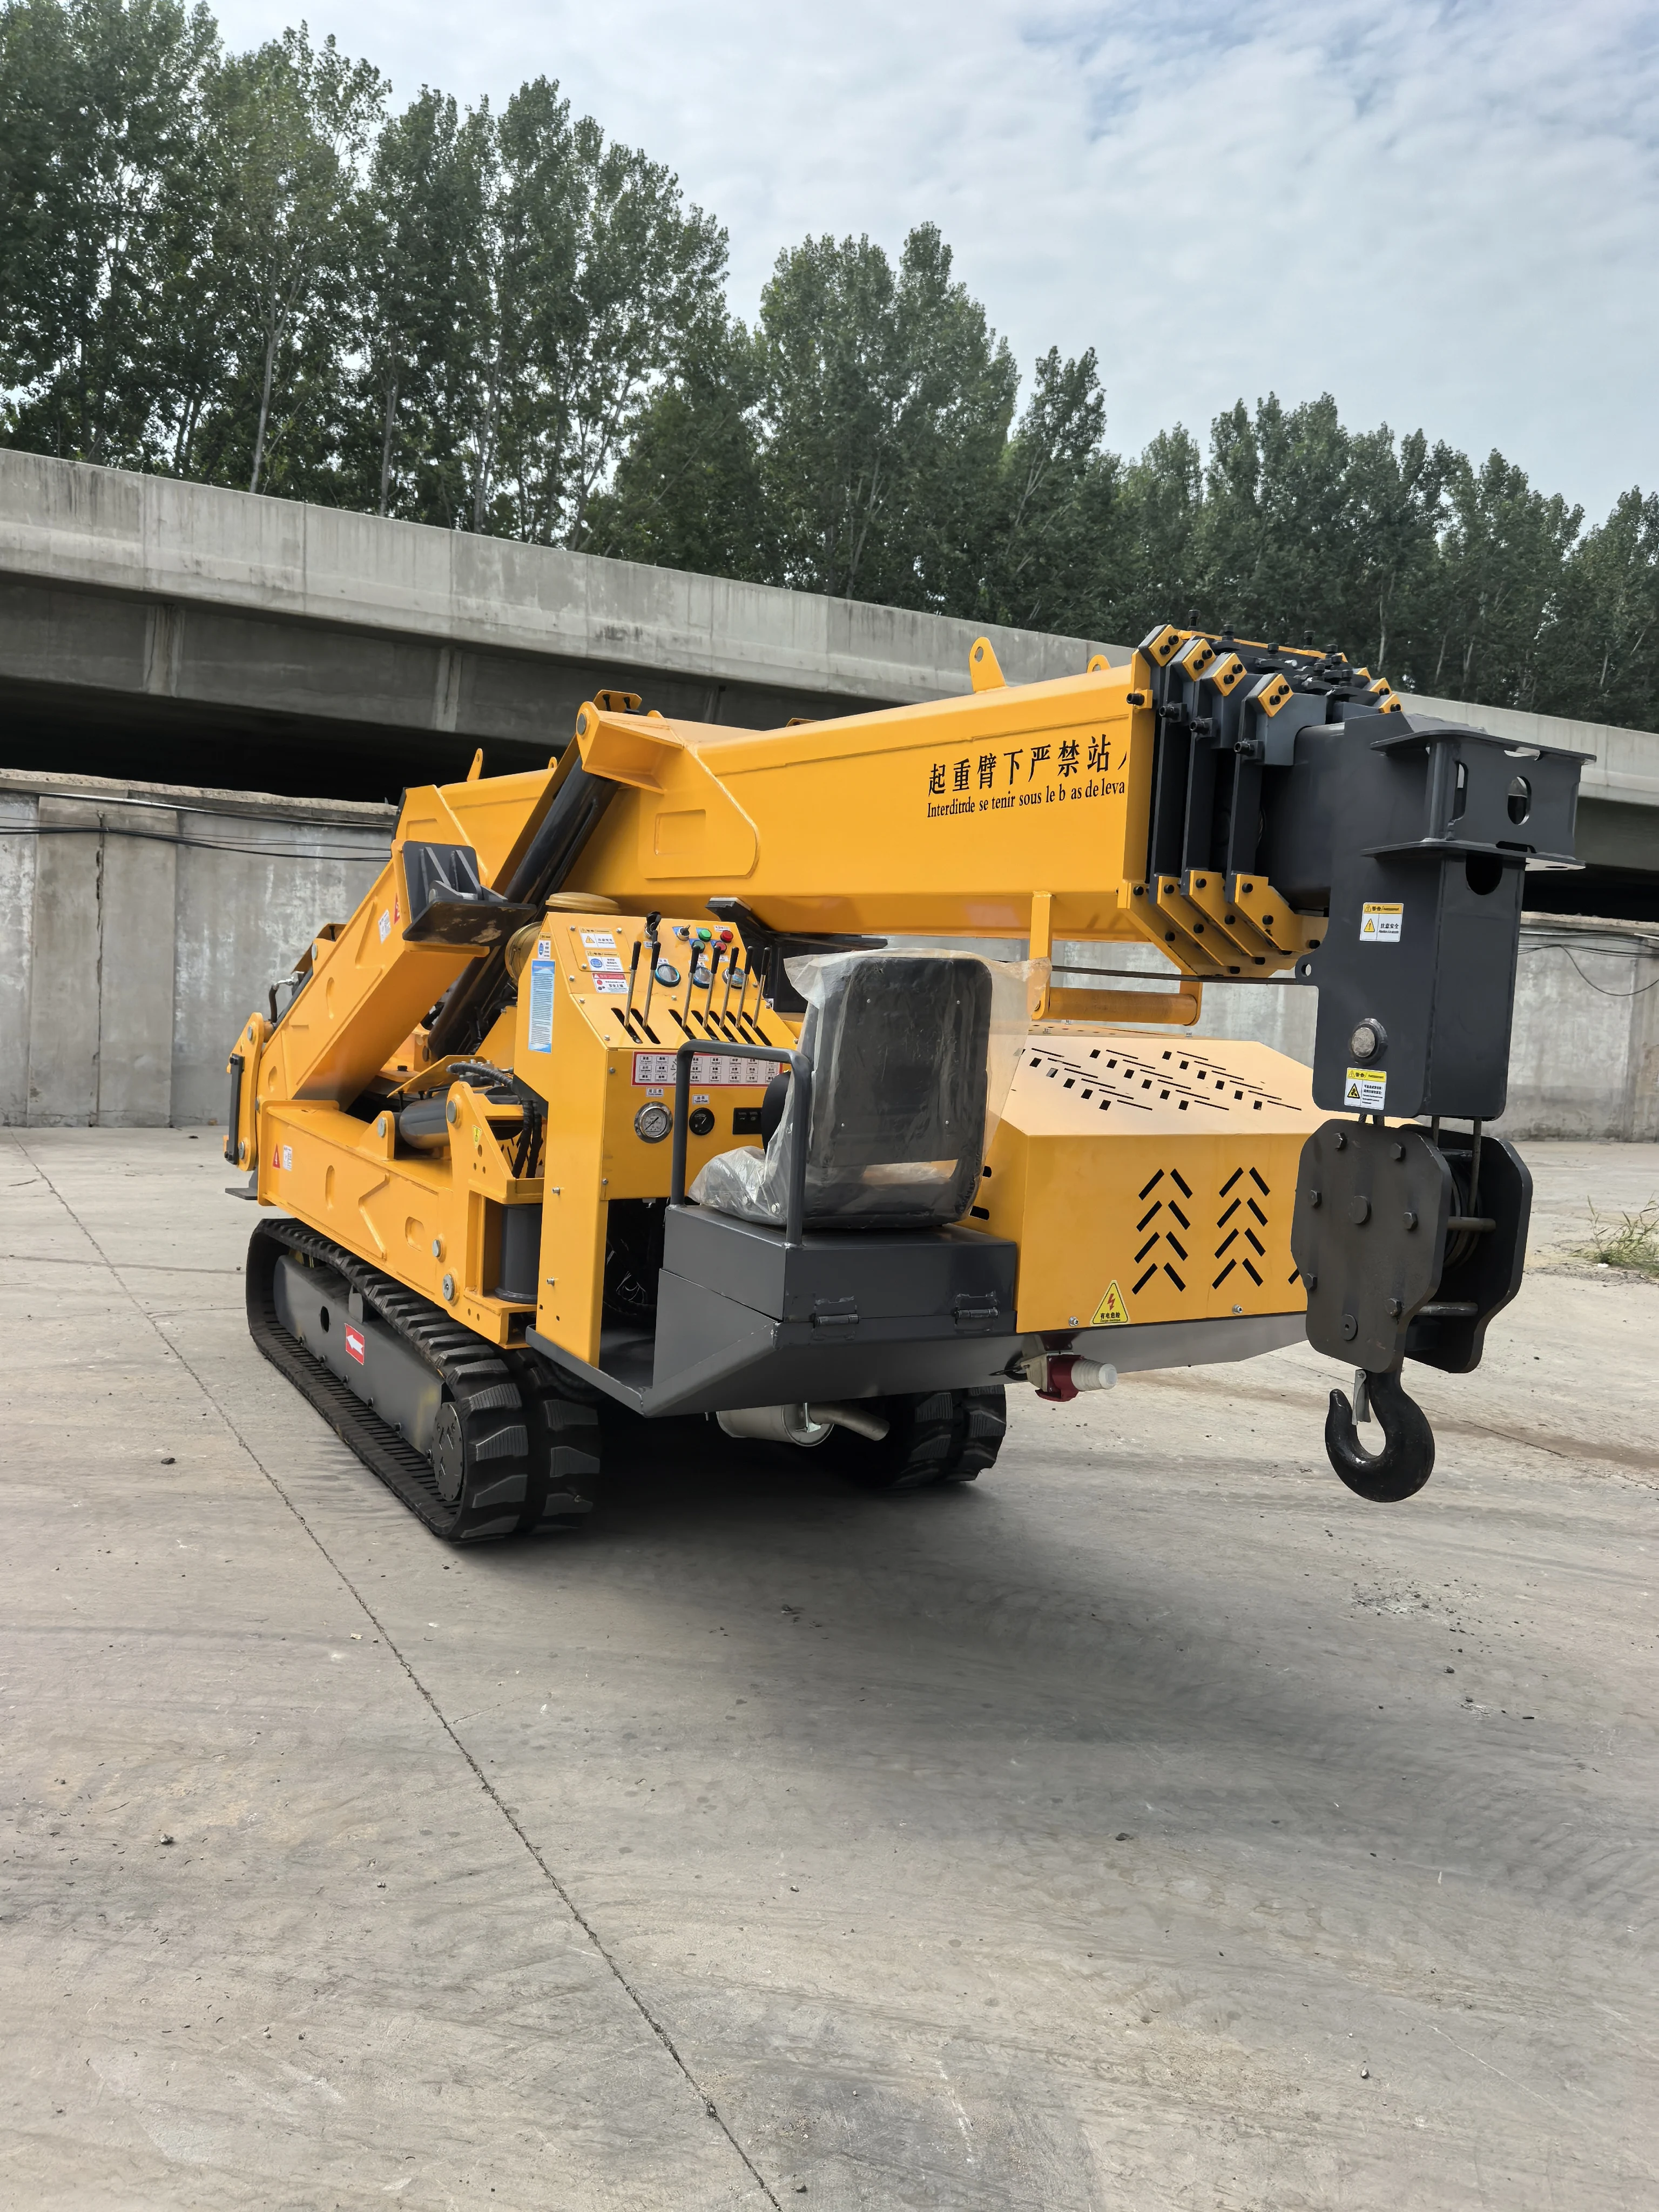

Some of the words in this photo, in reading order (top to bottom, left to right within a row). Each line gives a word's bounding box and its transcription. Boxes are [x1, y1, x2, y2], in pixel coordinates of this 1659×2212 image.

[979, 800, 989, 811] se
[992, 791, 1016, 810] tenir
[1019, 792, 1042, 806] sous
[1046, 785, 1055, 803] le
[1085, 779, 1099, 798] de
[1101, 778, 1125, 796] leva
